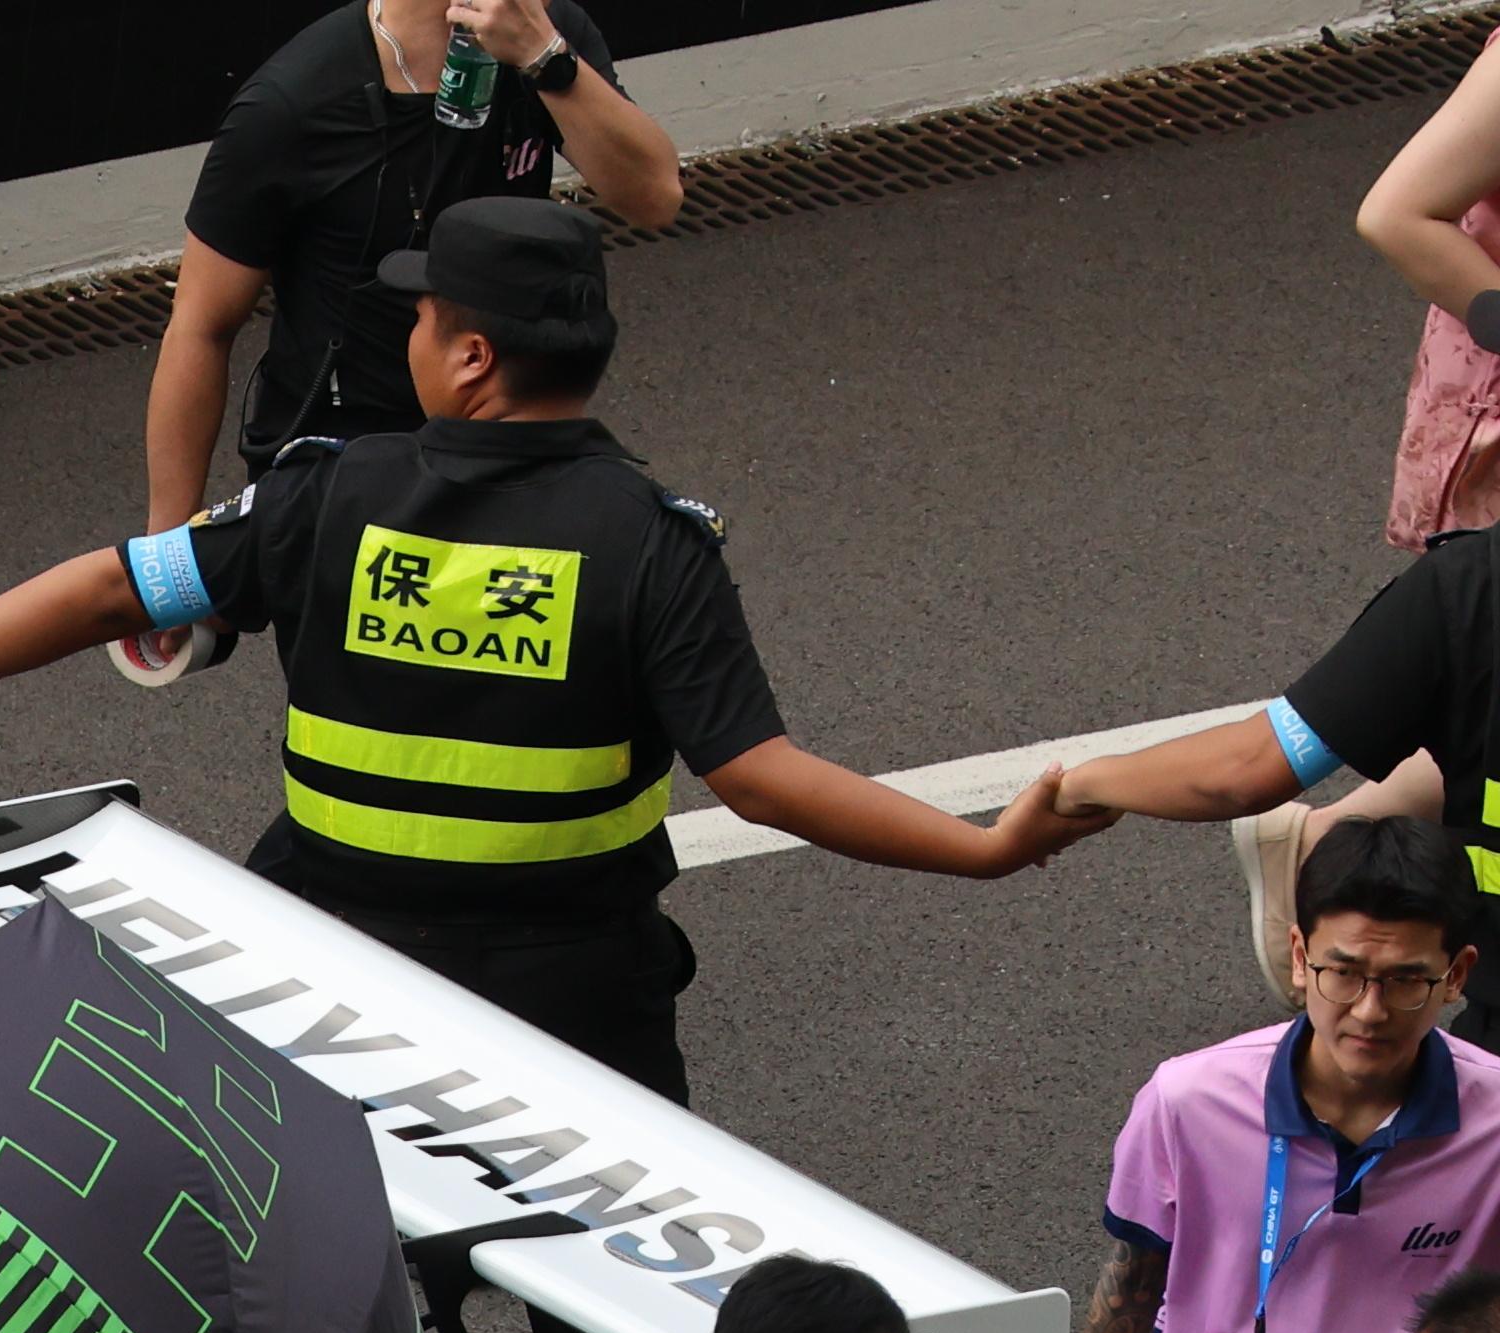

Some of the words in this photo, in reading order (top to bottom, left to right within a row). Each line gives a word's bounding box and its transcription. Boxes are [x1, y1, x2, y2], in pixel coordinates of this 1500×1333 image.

[366, 544, 555, 625] 保安
[358, 612, 552, 668] BAOAN
[1278, 700, 1307, 766] ICIAL
